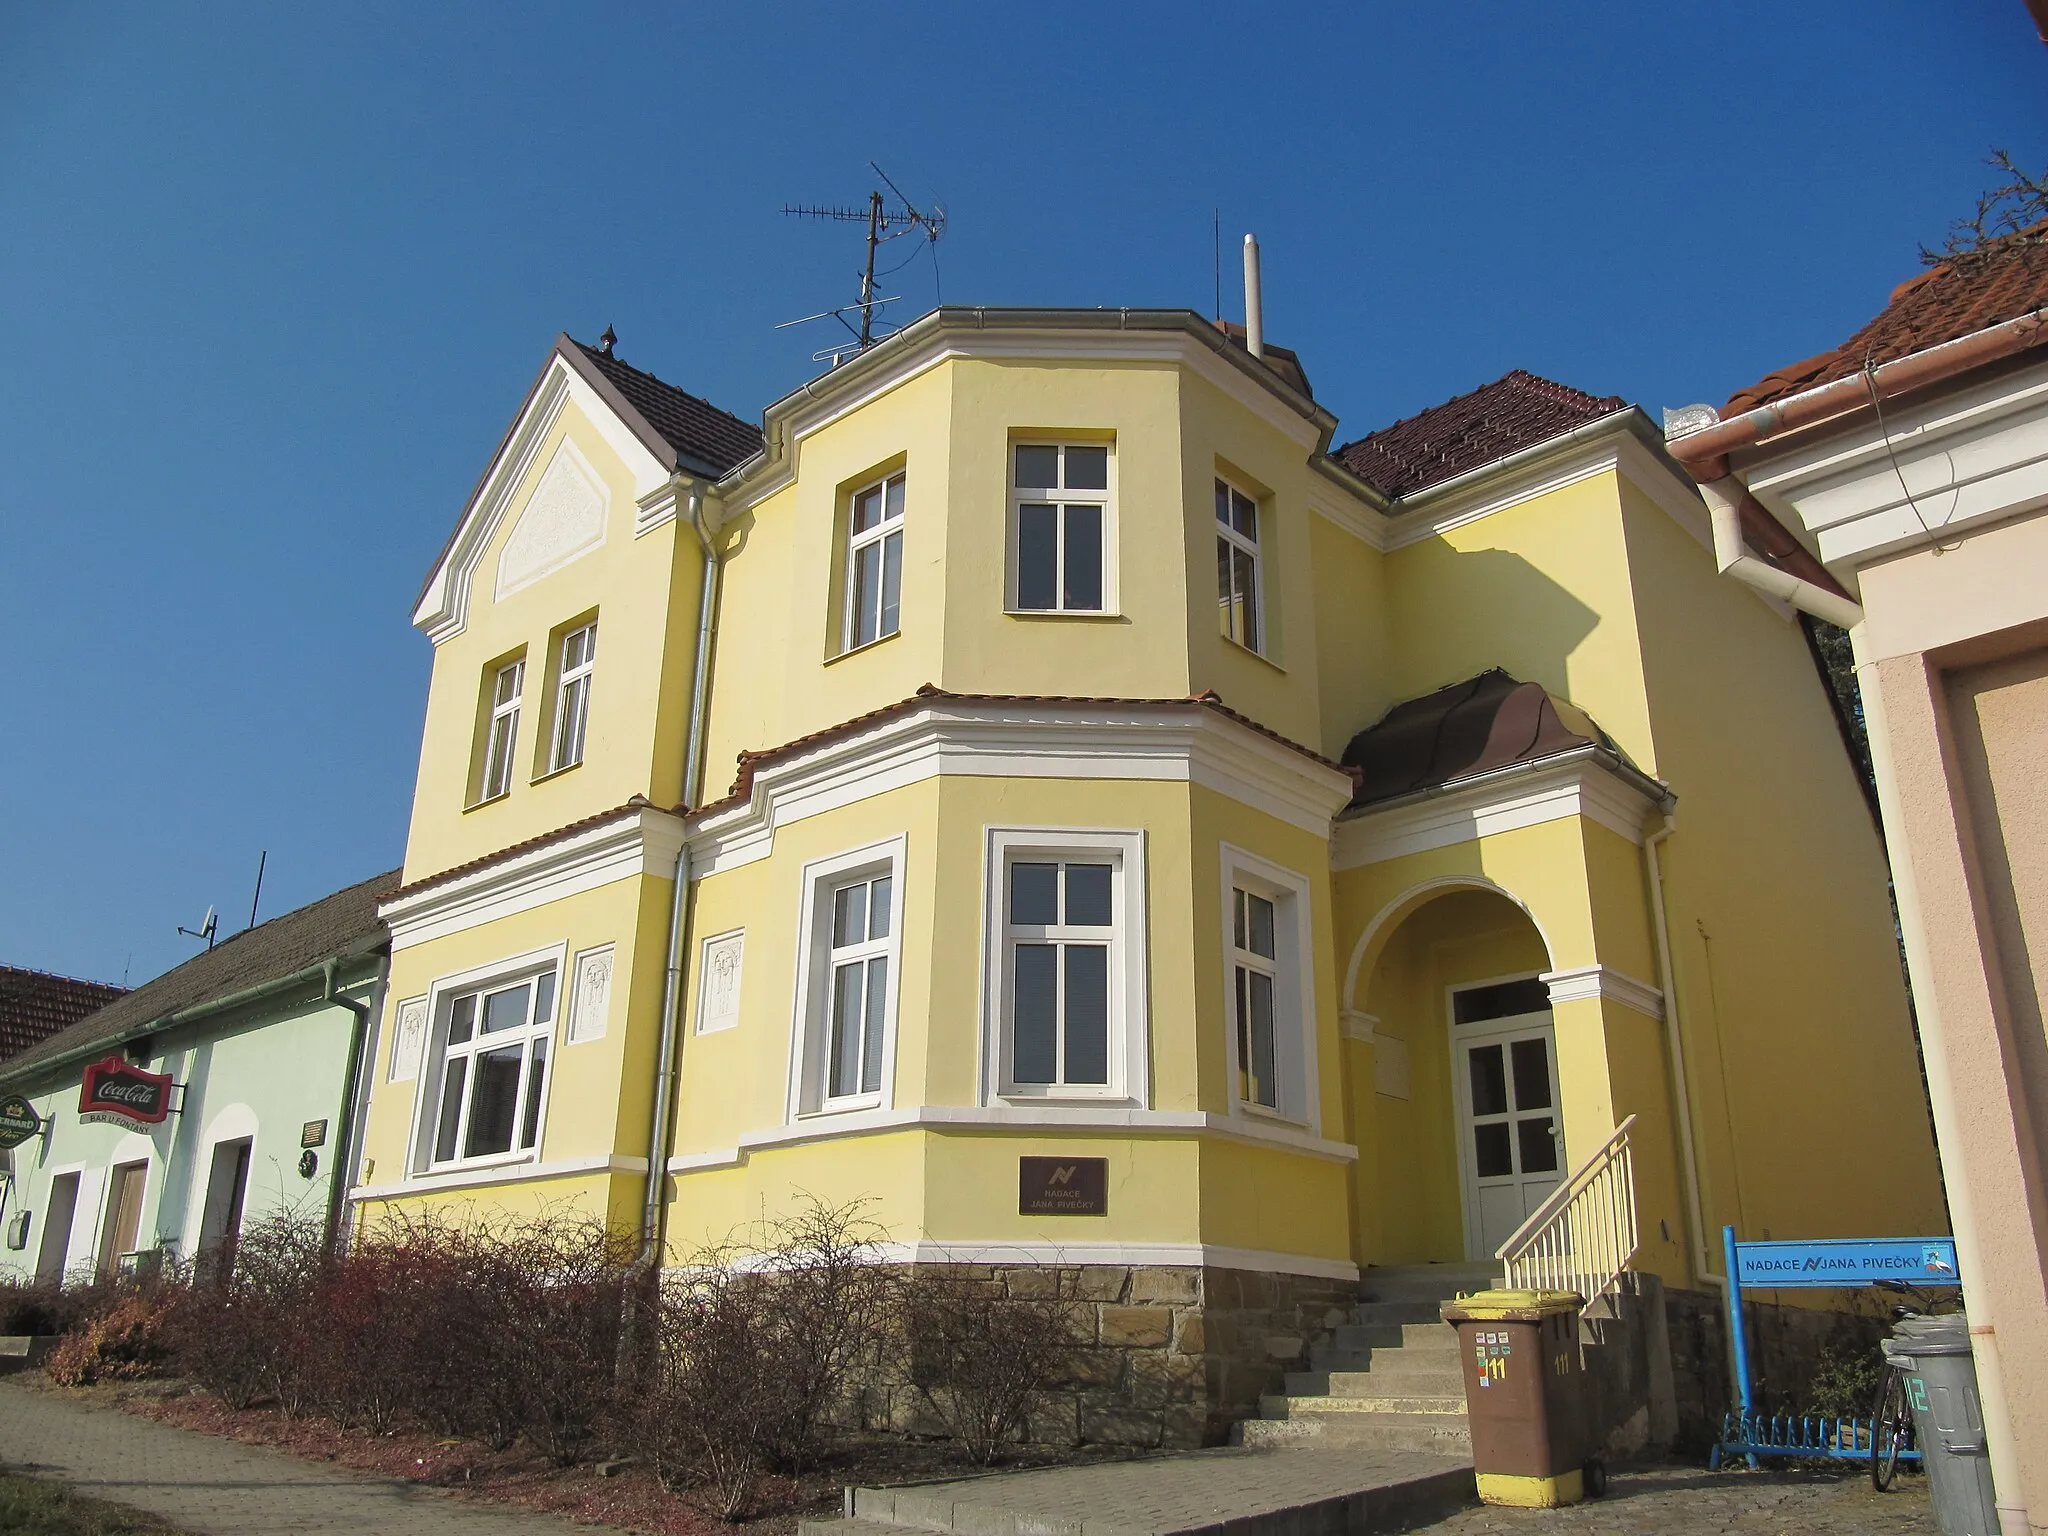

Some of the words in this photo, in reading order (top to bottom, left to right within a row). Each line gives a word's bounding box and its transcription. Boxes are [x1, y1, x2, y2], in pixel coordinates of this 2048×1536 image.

[0, 1117, 34, 1129] ERNARD
[90, 1115, 107, 1123] BAR
[108, 1115, 114, 1123] U
[115, 1117, 149, 1134] FONTANY
[1044, 1190, 1081, 1198] NADACE
[1031, 1200, 1054, 1209] JANA
[1058, 1199, 1094, 1209] PIVEČKY
[1746, 1259, 1801, 1271] NADACE
[1821, 1258, 1857, 1270] JANA
[1862, 1256, 1920, 1269] PIVEČKY
